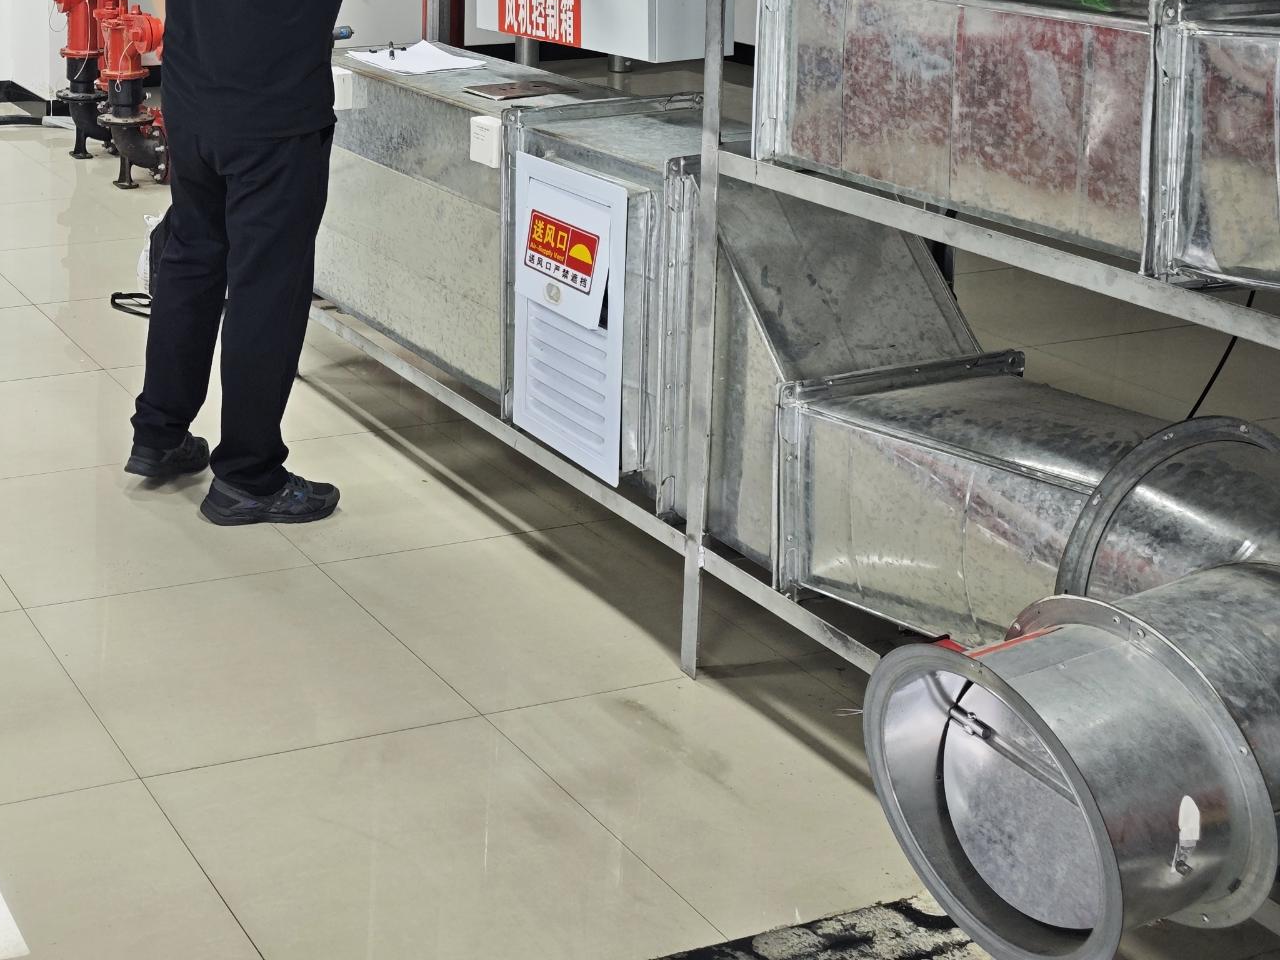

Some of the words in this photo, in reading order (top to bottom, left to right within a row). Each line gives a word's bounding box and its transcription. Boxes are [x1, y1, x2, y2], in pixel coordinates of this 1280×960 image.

[531, 218, 568, 252] 送风口
[528, 253, 588, 288] 送风口严禁遮挡
